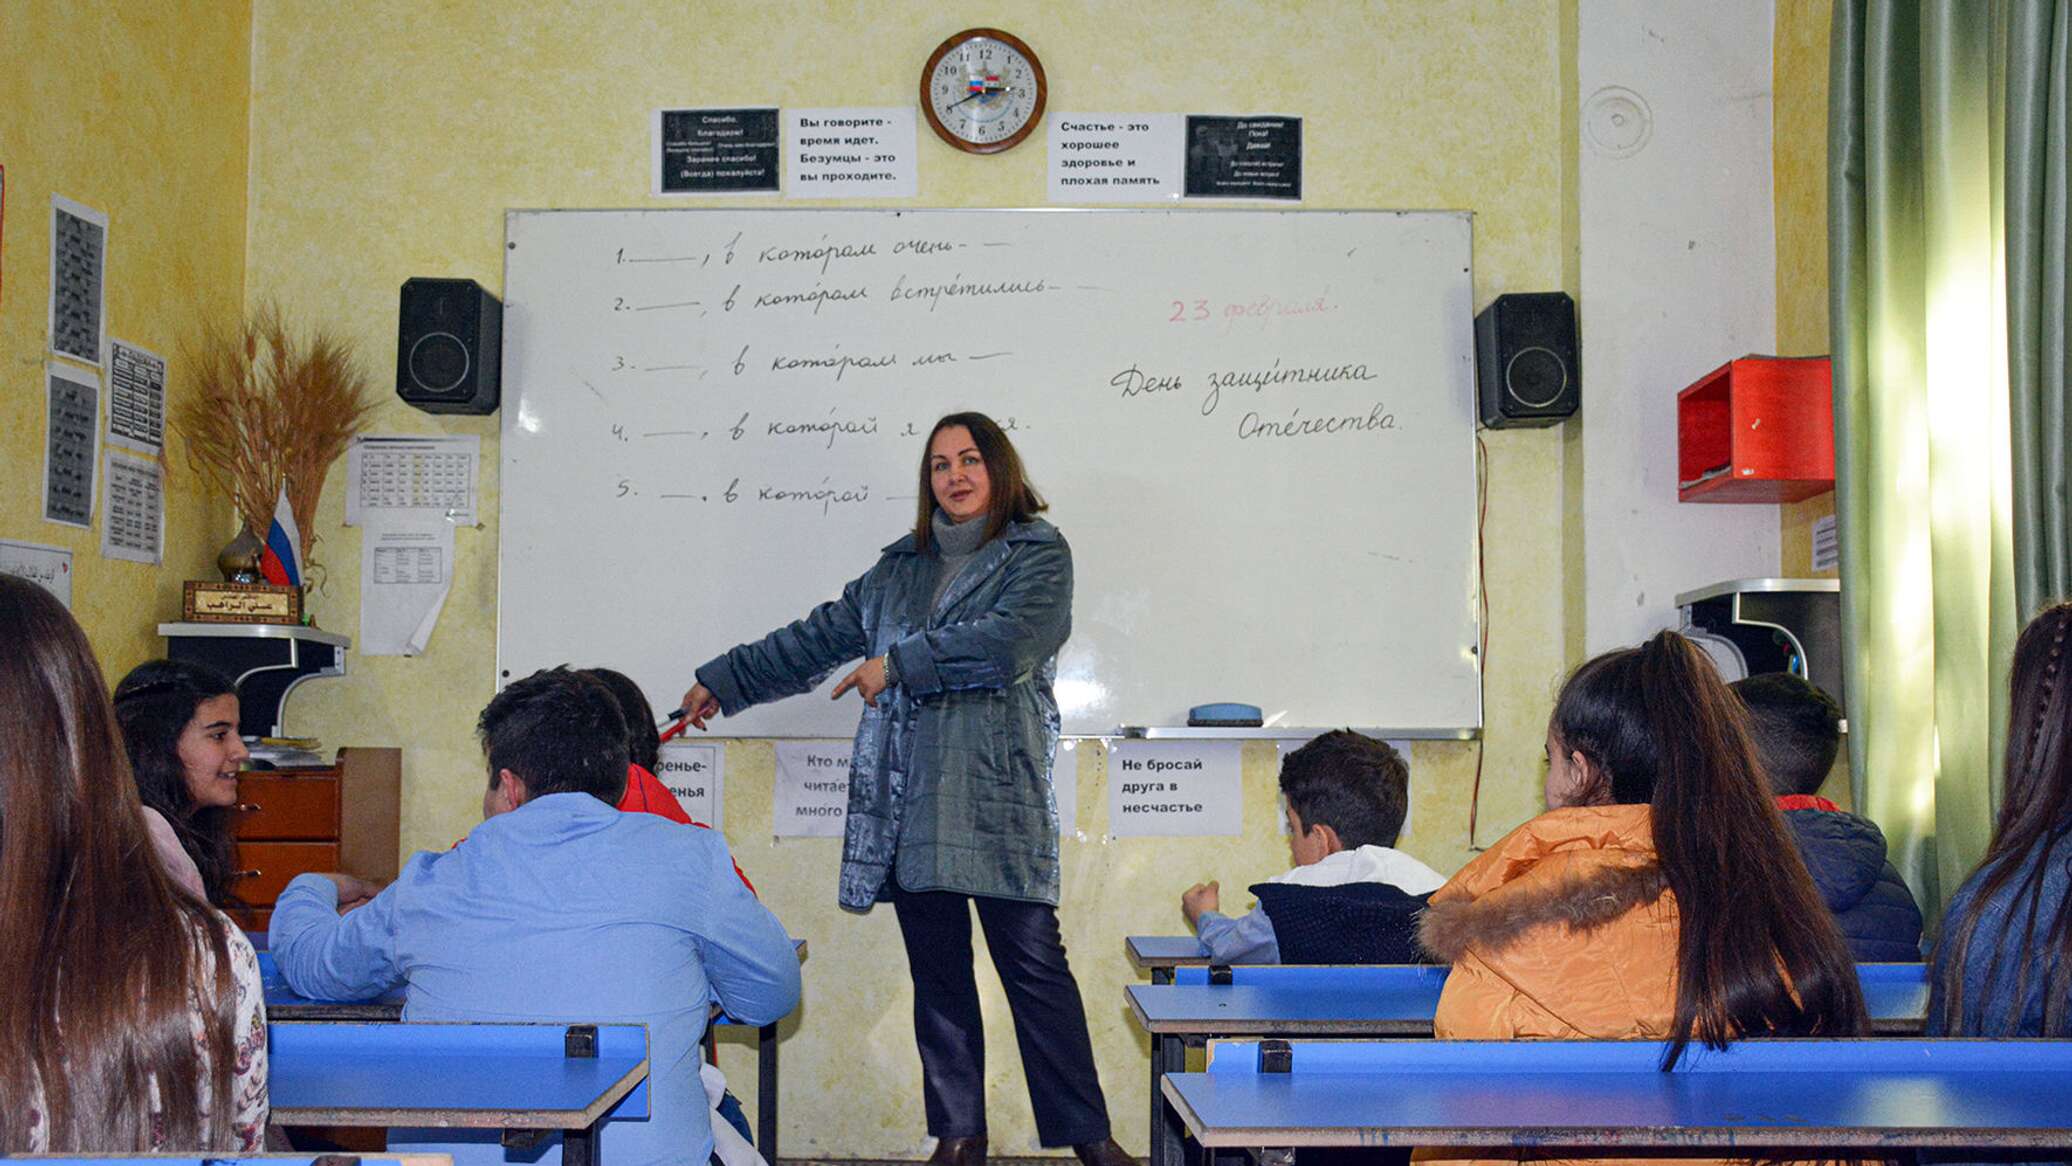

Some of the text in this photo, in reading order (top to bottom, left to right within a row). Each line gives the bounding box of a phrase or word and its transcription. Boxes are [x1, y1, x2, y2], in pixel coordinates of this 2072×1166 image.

[959, 53, 970, 62] 11
[979, 49, 992, 60] 12
[942, 65, 957, 76] 10
[1015, 68, 1023, 80] 2
[941, 85, 949, 95] 9
[1017, 88, 1026, 99] 3
[800, 118, 820, 128] Вы
[823, 118, 884, 129] говорите
[959, 118, 967, 130] 7
[998, 120, 1005, 132] 5
[1060, 121, 1116, 132] Счастье
[1127, 123, 1150, 132] это
[978, 125, 986, 136] 6
[800, 136, 879, 147] время идет.
[1061, 140, 1120, 150] хорошее
[800, 153, 862, 165] Безумцы
[874, 154, 896, 163] это
[1061, 158, 1136, 168] здоровье и
[800, 172, 897, 183] вы проходите.
[1061, 176, 1160, 186] плохая память
[723, 283, 741, 312] в
[731, 344, 750, 376] в
[1110, 363, 1183, 399] День
[729, 411, 750, 441] в
[723, 477, 740, 504] в
[806, 754, 833, 768] Кто
[1122, 758, 1203, 774] Не бросай
[656, 761, 707, 774] ренье-
[671, 787, 705, 798] енья
[1121, 781, 1178, 795] друга в
[795, 806, 843, 818] много
[1122, 802, 1203, 814] несчастье
